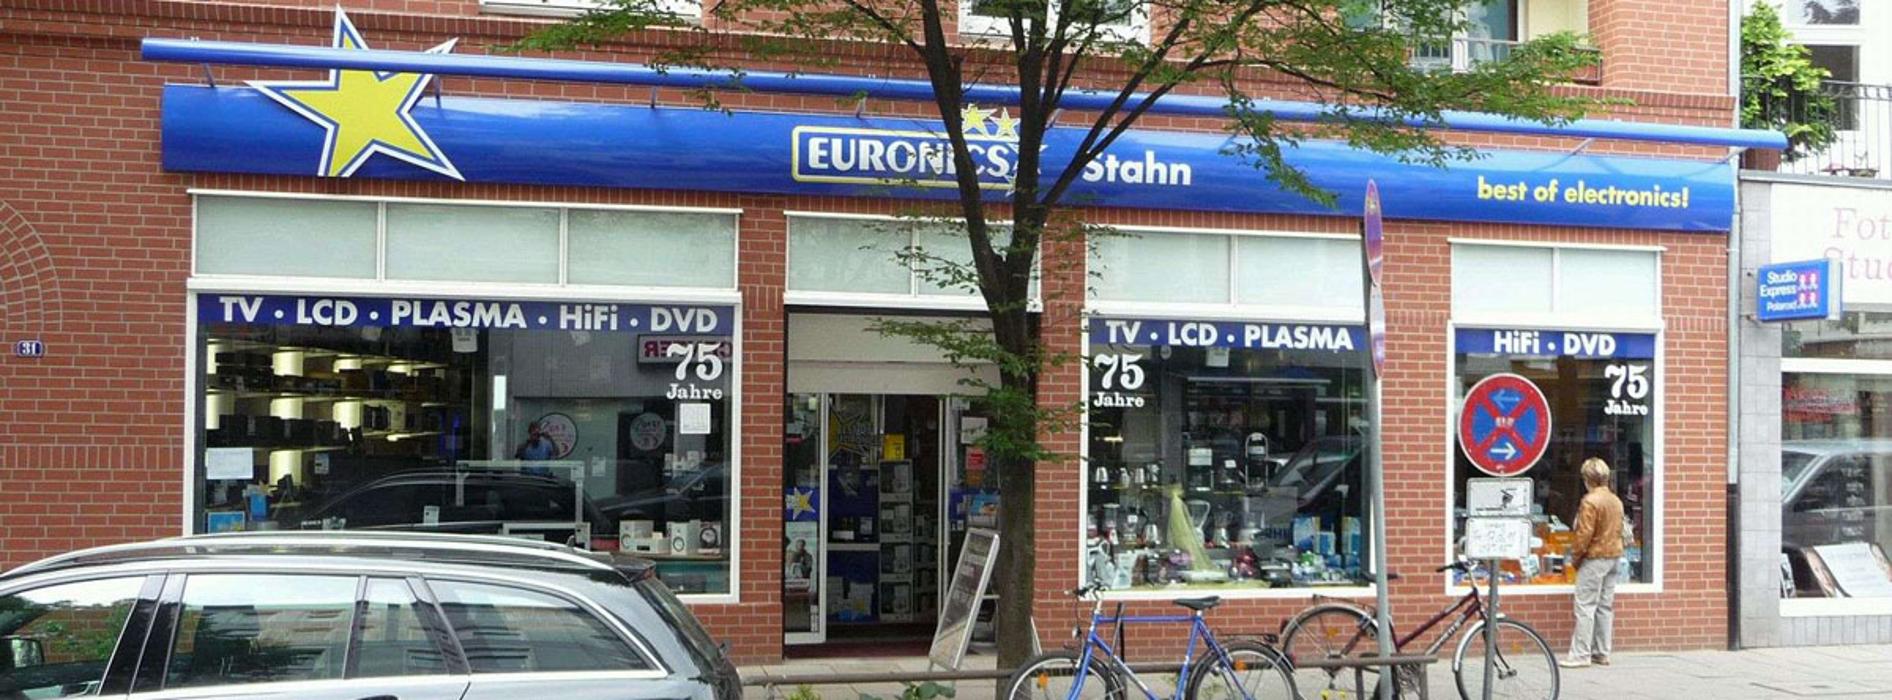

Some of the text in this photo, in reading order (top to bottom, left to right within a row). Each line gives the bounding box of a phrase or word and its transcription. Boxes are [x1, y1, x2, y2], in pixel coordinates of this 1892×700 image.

[1082, 150, 1192, 186] Stahn
[1477, 175, 1689, 208] best of electronics!
[1760, 285, 1797, 298] Express
[1766, 269, 1797, 284] Studio
[219, 296, 719, 333] TV LCD PLASMA HiFi DVD
[1105, 319, 1354, 350] TV LCD PLASMA
[1493, 330, 1617, 356] HiFi DVD
[666, 342, 723, 381] 75
[1094, 353, 1145, 390] 75
[666, 383, 723, 400] Jahre
[1604, 364, 1649, 399] 75
[1093, 392, 1145, 408] Jahre
[1604, 400, 1649, 416] Jahre
